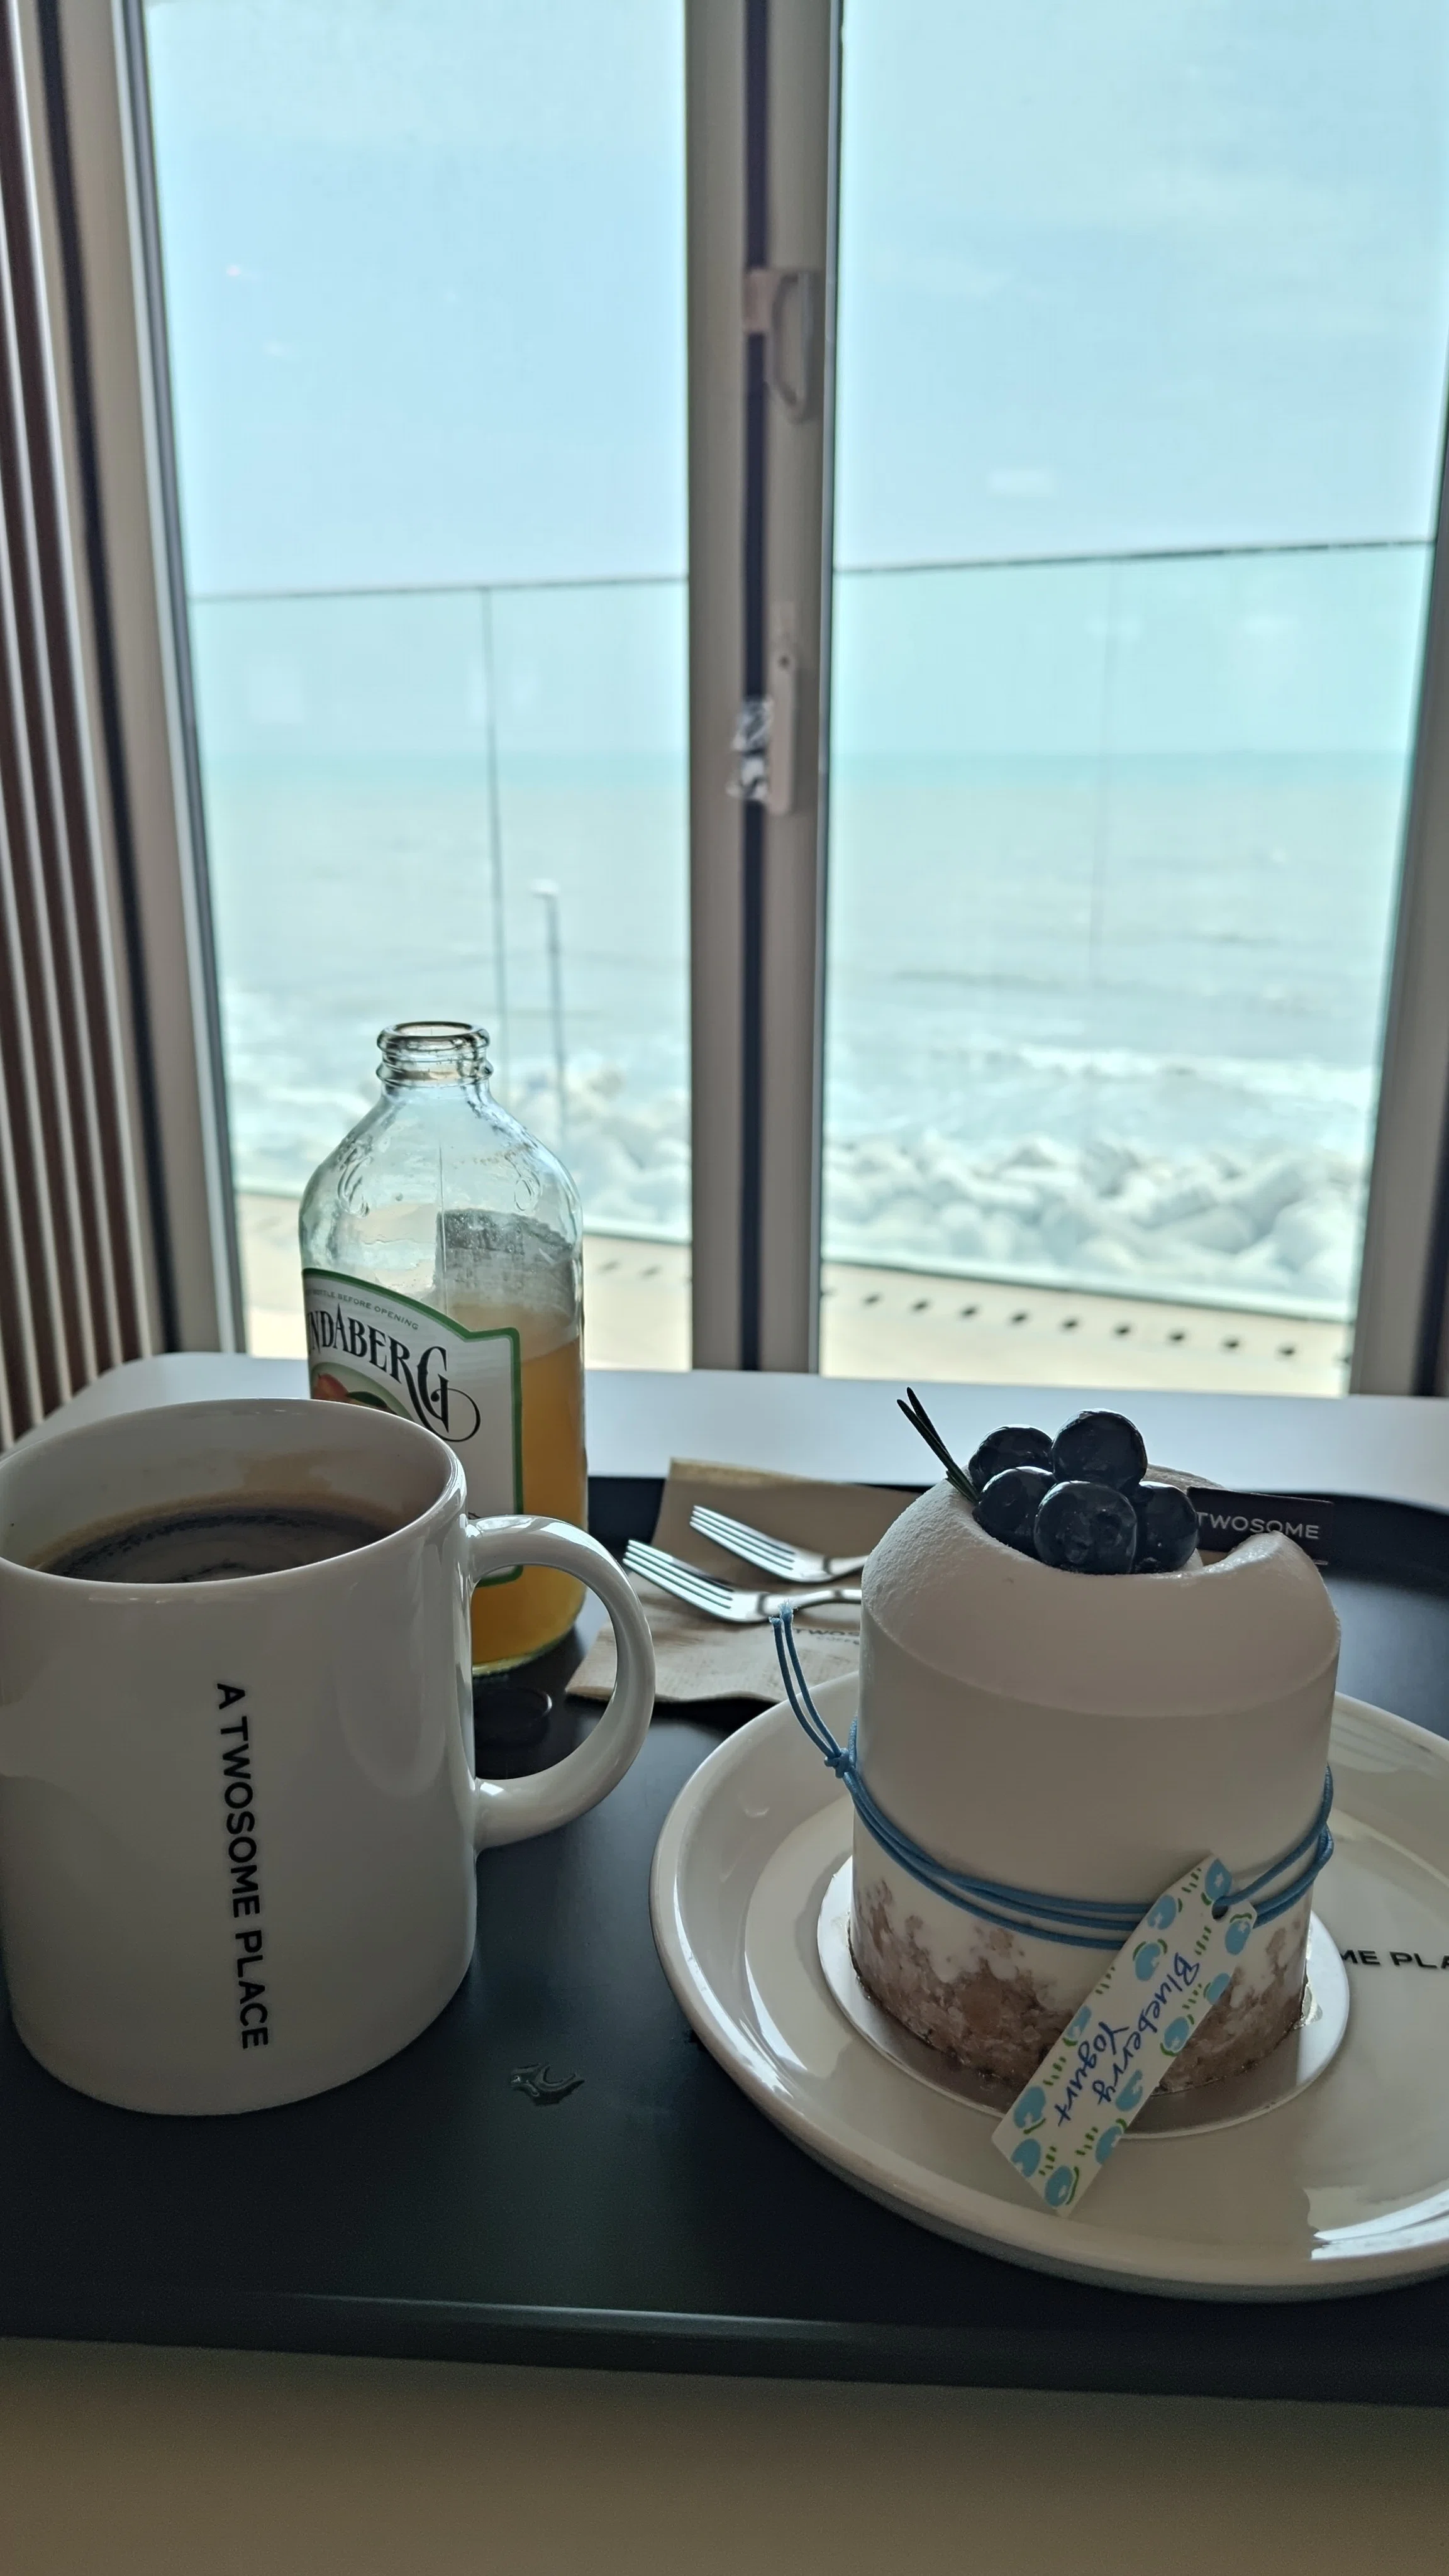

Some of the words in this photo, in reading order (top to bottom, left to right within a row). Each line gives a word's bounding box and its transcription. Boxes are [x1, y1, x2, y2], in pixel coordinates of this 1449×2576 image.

[338, 1293, 372, 1309] BEFORE
[374, 1305, 419, 1331] OPENING
[1197, 1512, 1319, 1540] TWOSOME
[217, 1682, 246, 1710] A
[220, 1716, 260, 1918] TWOSOME
[235, 1929, 269, 2050] PLACE
[1092, 1952, 1200, 2106] Blueberry
[1054, 2021, 1130, 2127] Yogurt
